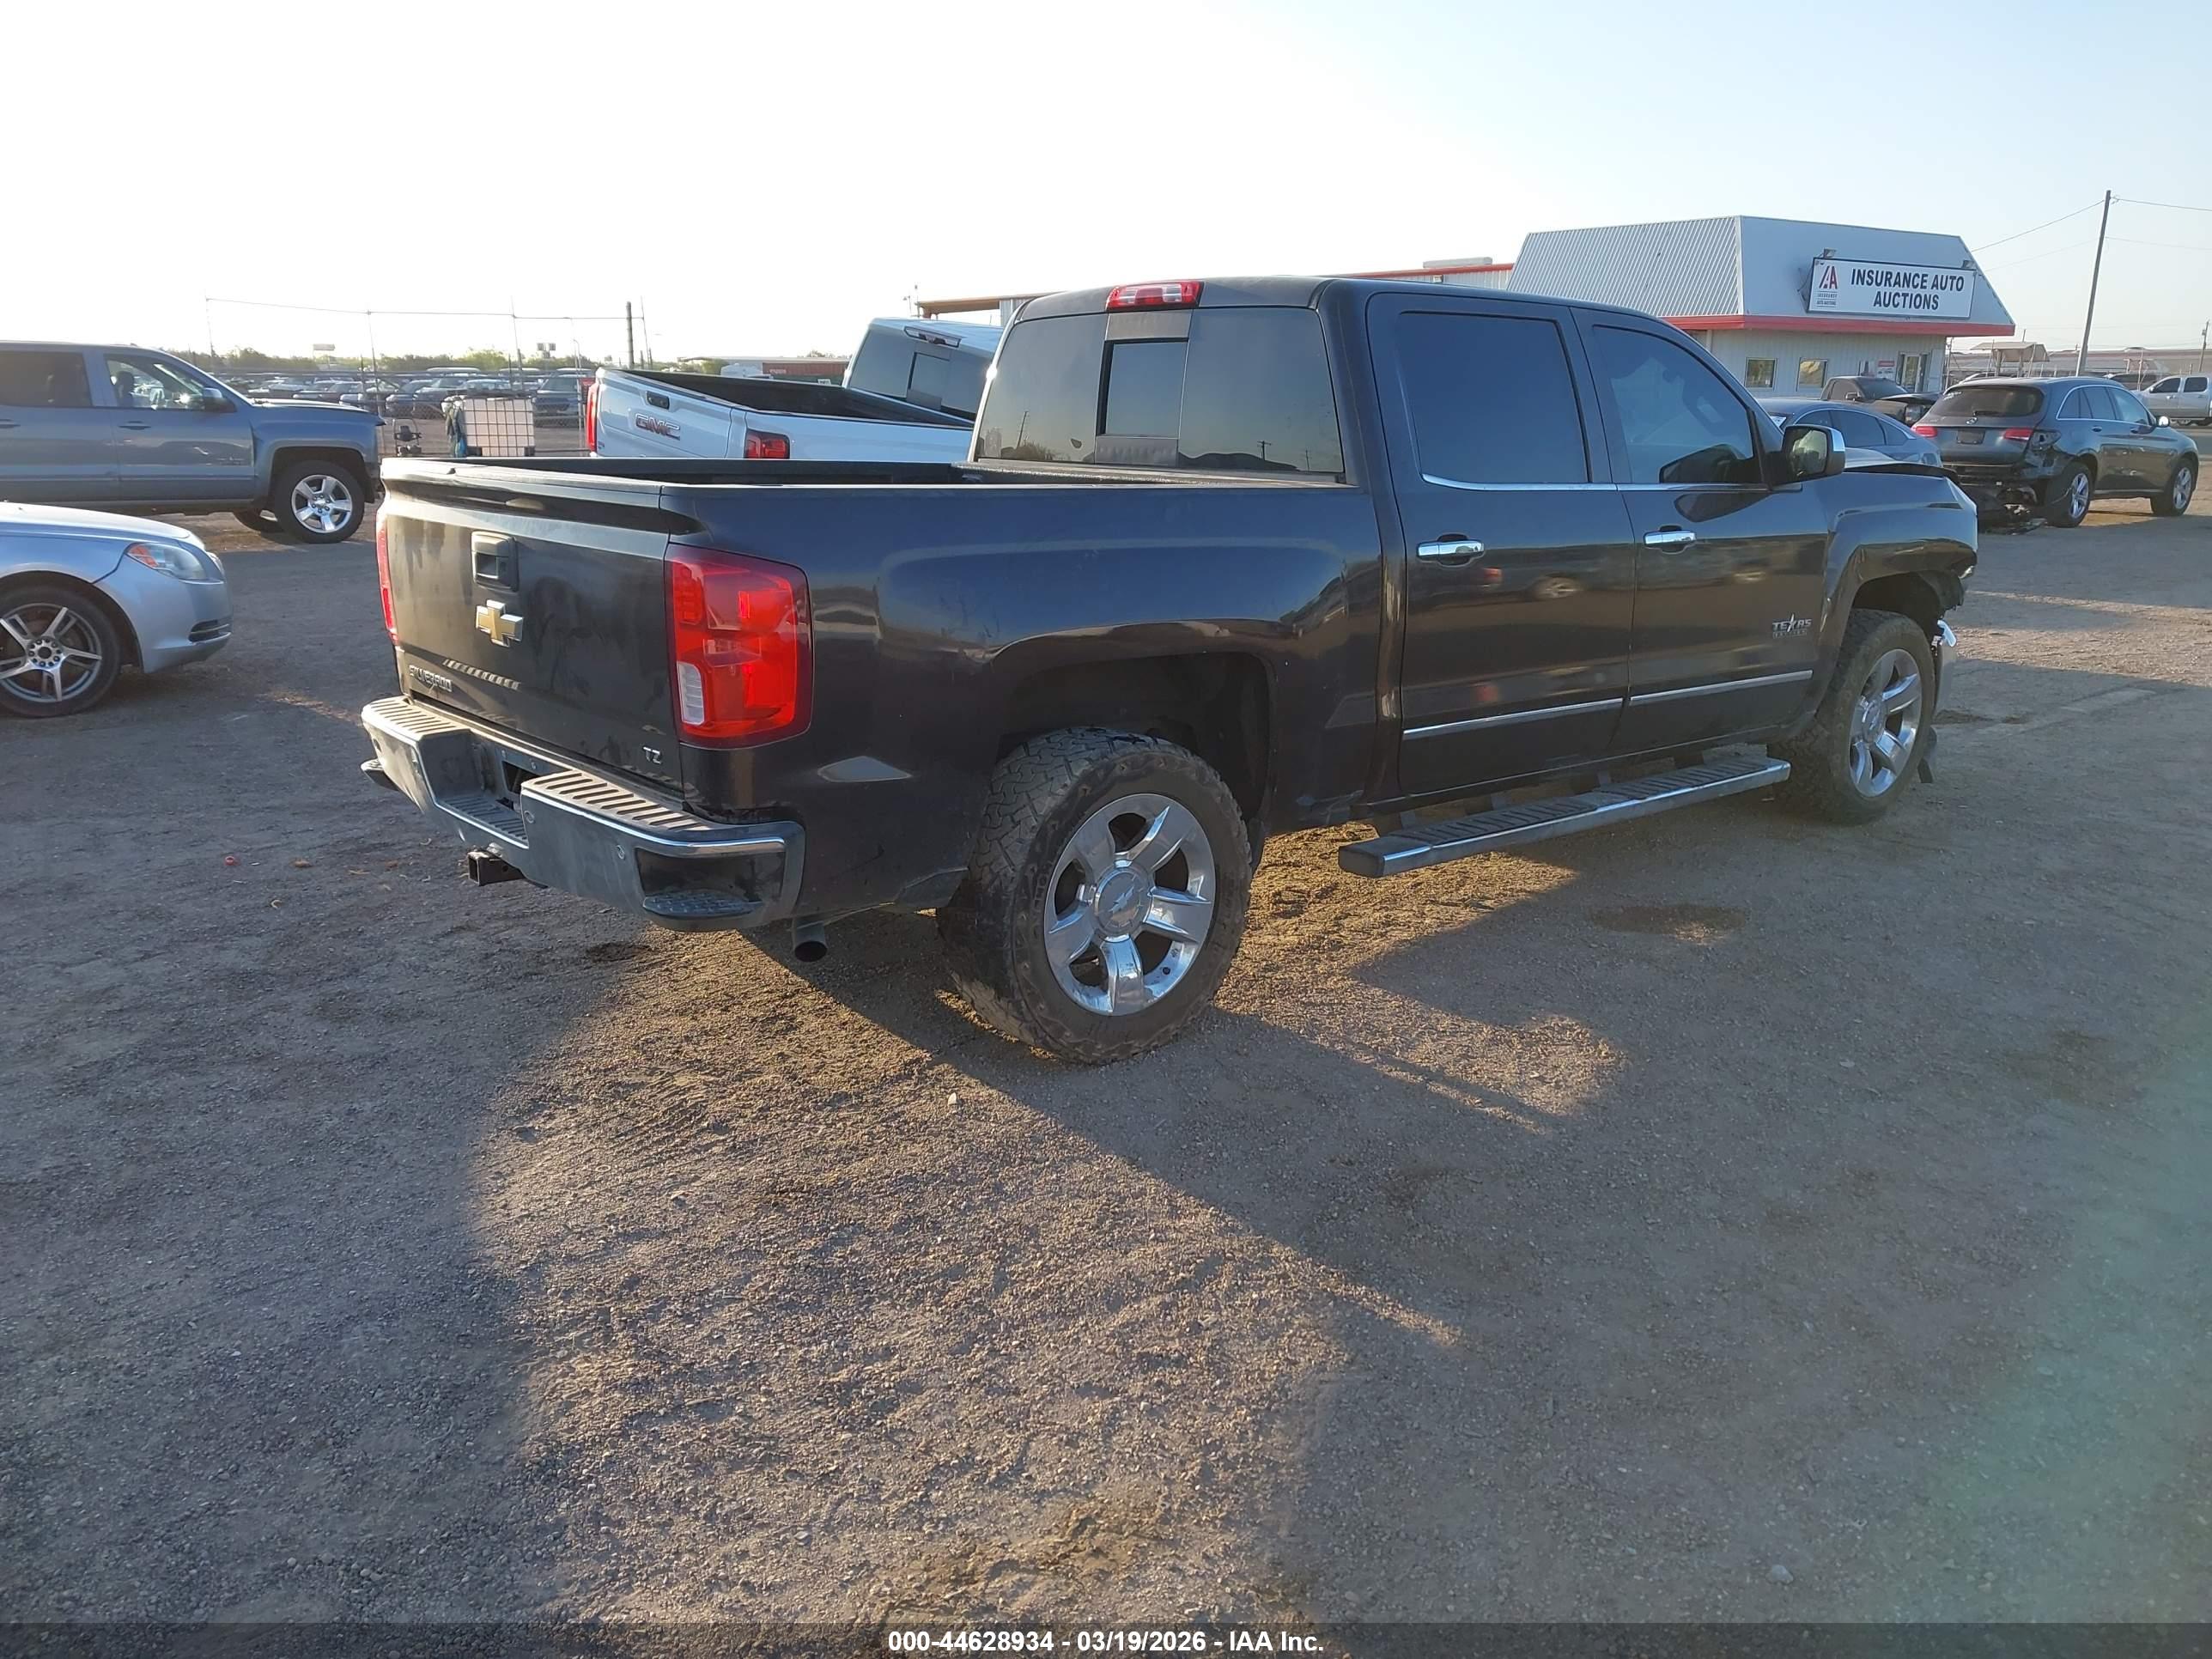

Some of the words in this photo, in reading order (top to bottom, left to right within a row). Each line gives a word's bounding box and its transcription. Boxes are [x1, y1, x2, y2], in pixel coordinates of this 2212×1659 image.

[1851, 268, 1928, 289] INSURANCE
[1931, 274, 1964, 292] AUTO
[1873, 291, 1939, 310] AUCTIONS
[635, 413, 680, 441] GMC
[1772, 613, 1812, 632] TEXAS
